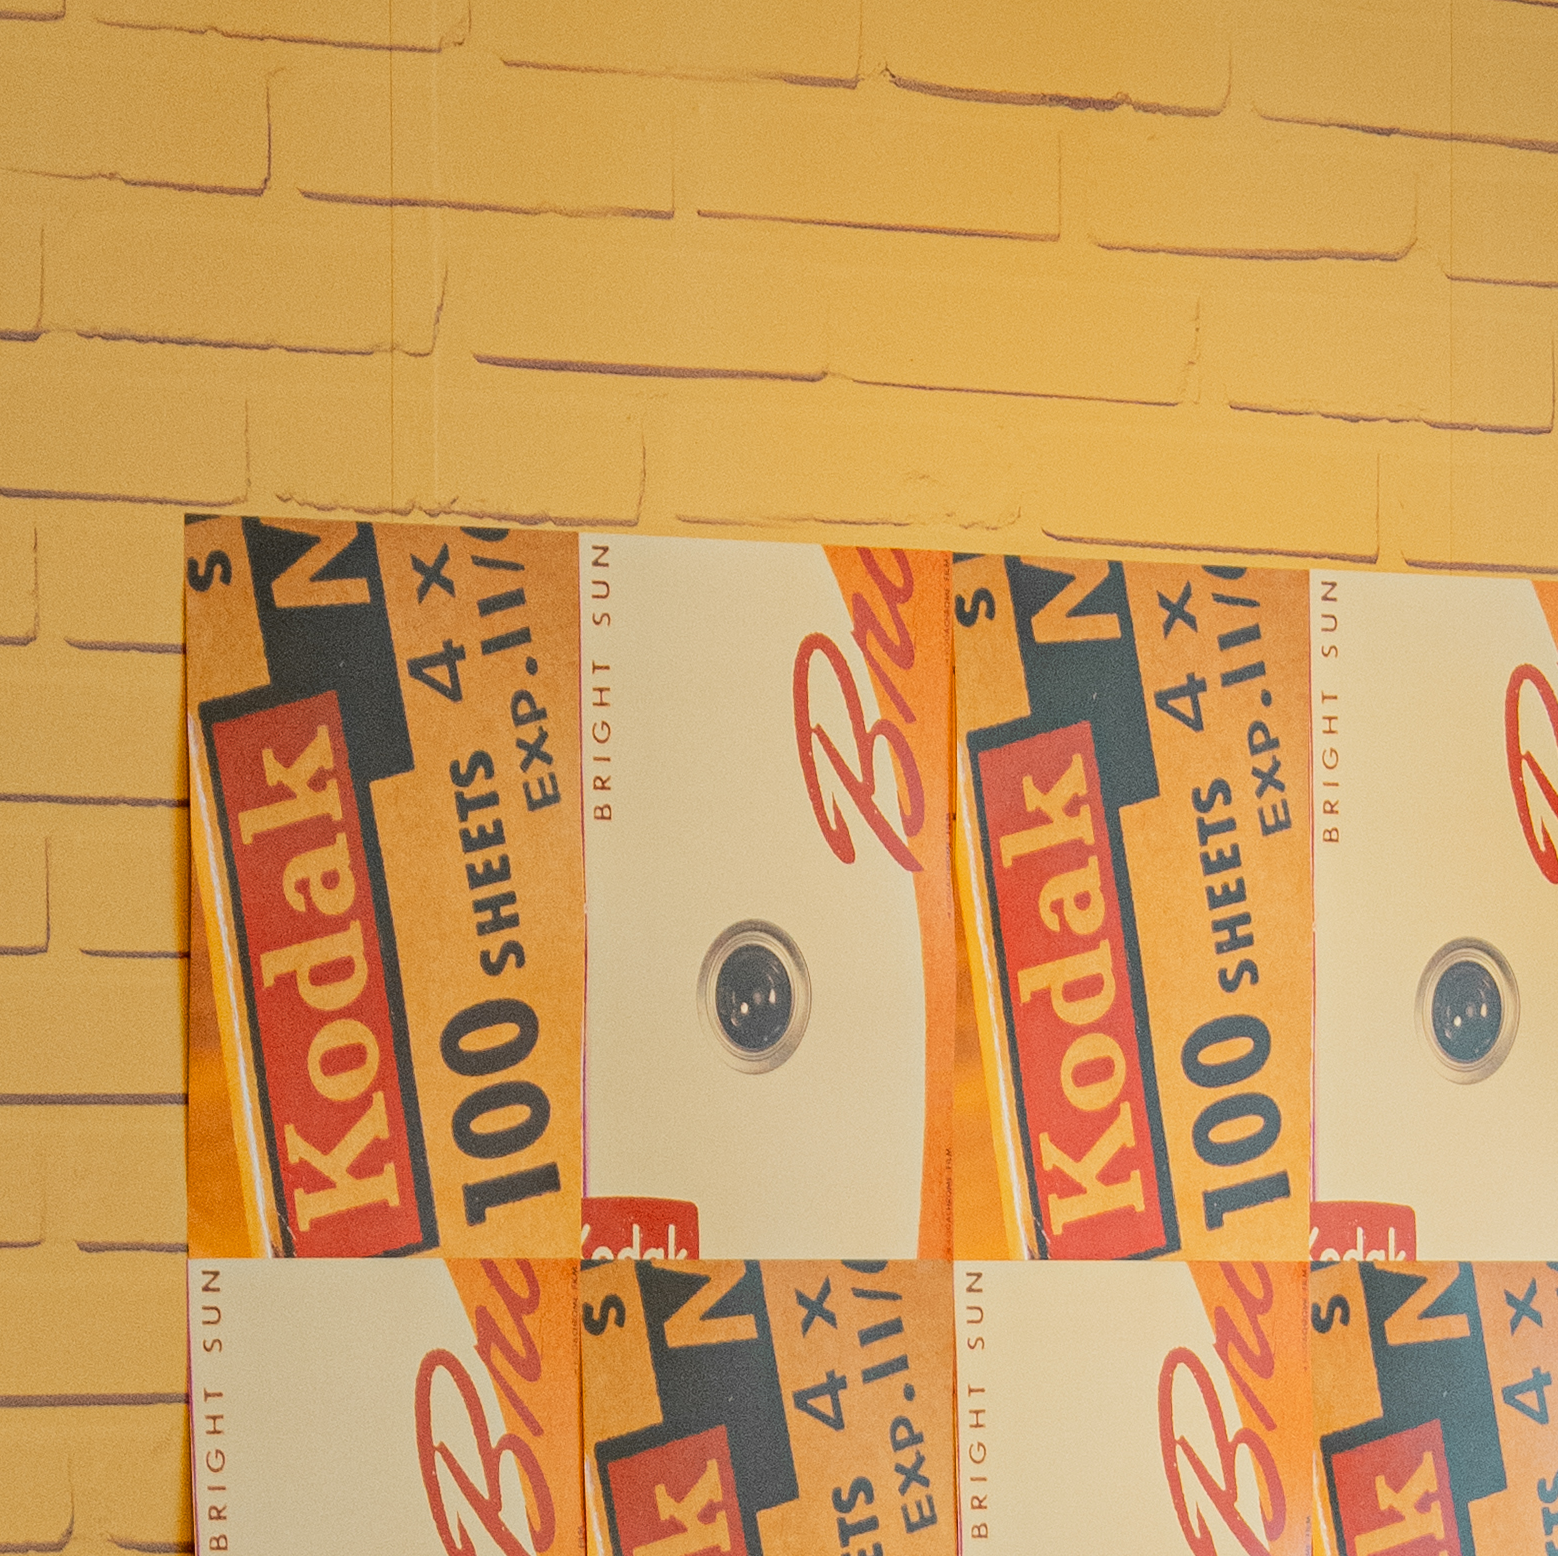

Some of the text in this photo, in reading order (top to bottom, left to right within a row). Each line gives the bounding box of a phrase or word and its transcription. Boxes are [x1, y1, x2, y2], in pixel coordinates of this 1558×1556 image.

[406, 641, 468, 704] 4
[591, 545, 613, 823] BRIGHT SUN
[1153, 671, 1208, 734] 4
[1319, 580, 1340, 845] BRIGHT SUN
[448, 749, 527, 977] SHEETS
[1190, 776, 1260, 996] SHEETS
[239, 725, 402, 1233] Kodak
[999, 752, 1148, 1236] Kodak
[438, 998, 563, 1227] 100
[1180, 1012, 1293, 1232] 100
[200, 1268, 229, 1553] BRIGHT SUN
[791, 1370, 849, 1432] 4
[965, 1270, 990, 1540] BRIGHT SUN
[1502, 1366, 1553, 1426] 4
